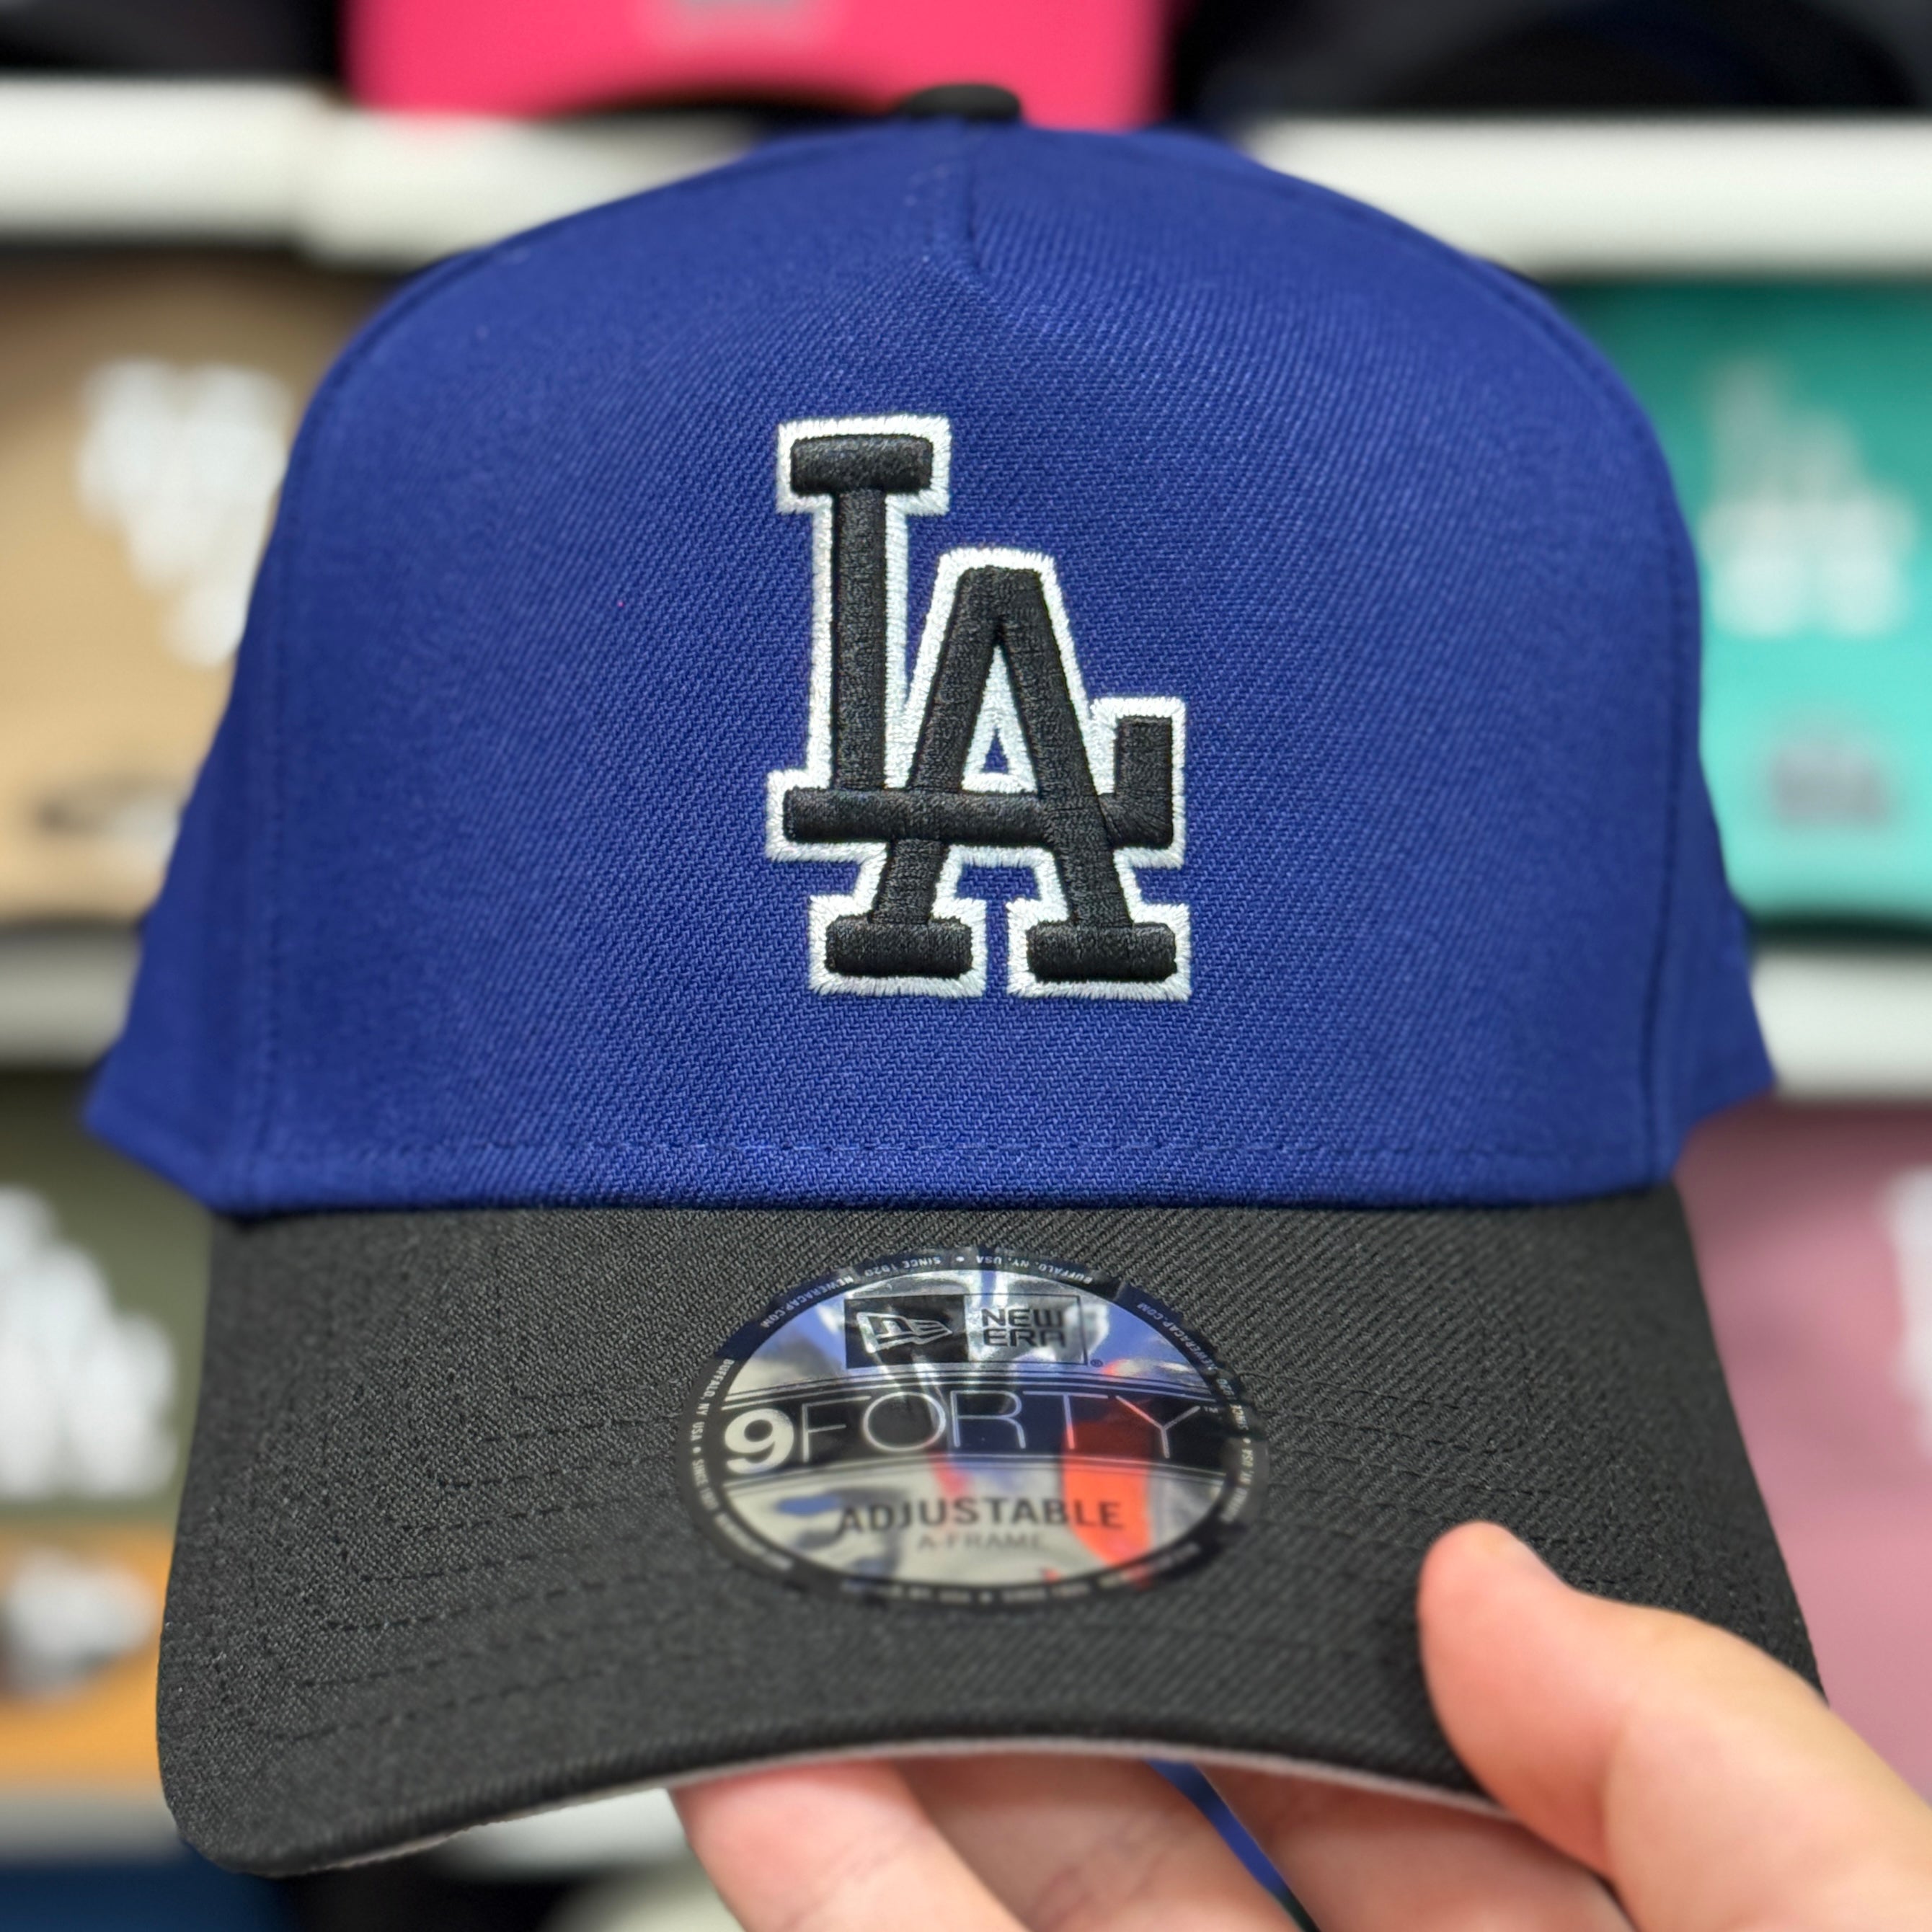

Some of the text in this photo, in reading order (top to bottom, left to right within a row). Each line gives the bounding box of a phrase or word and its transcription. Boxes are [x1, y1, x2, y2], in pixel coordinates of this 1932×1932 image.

[766, 415, 1193, 1001] LA
[903, 1257, 941, 1269] SINCE
[975, 1255, 1002, 1265] USA
[759, 1275, 855, 1329] NEWERACAP.COM
[981, 1307, 1065, 1329] NEW
[983, 1328, 1066, 1348] ERA
[690, 1421, 705, 1441] USA
[724, 1389, 1202, 1474] 9FORTY
[838, 1494, 1126, 1534] ADJUSTABLE
